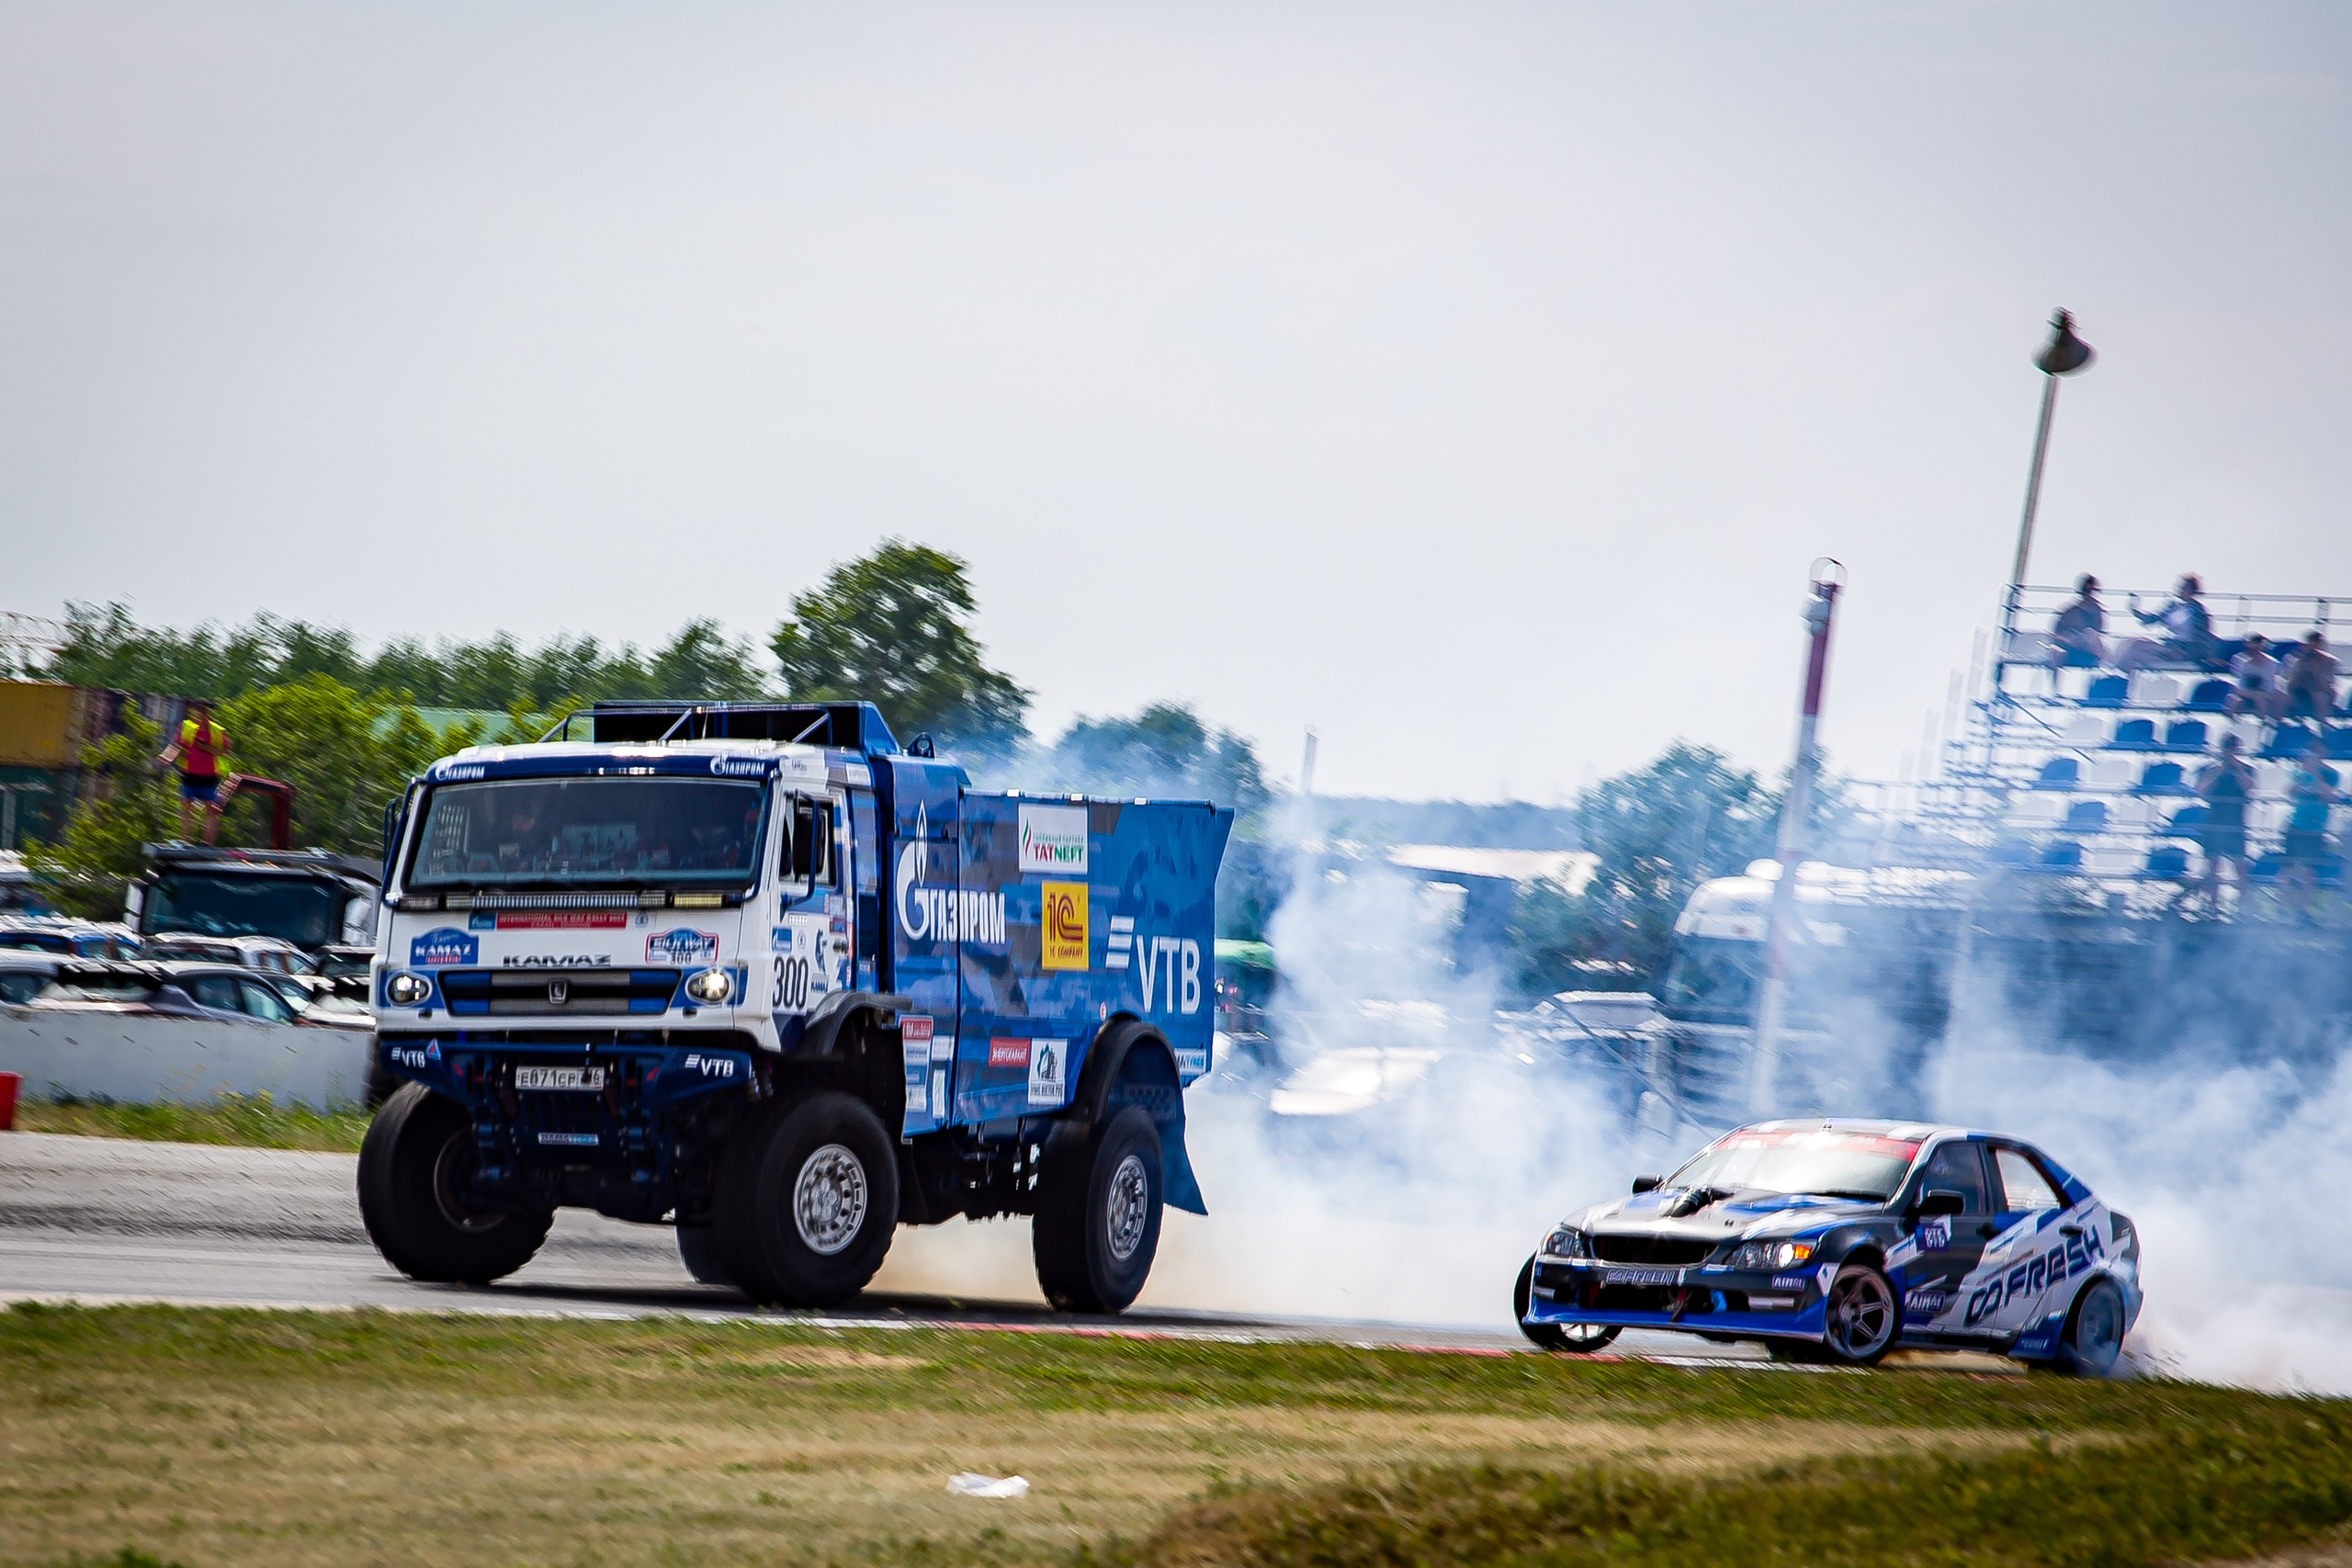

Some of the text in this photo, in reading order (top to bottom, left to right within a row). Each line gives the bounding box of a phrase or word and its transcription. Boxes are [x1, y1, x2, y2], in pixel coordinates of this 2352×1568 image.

[1034, 842, 1084, 863] TATNEFT
[929, 888, 1006, 945] ГАЗПРОМ
[503, 954, 612, 967] KAMAZ
[1136, 934, 1201, 1015] VTB
[772, 955, 808, 1009] 300
[701, 1058, 734, 1077] VTB
